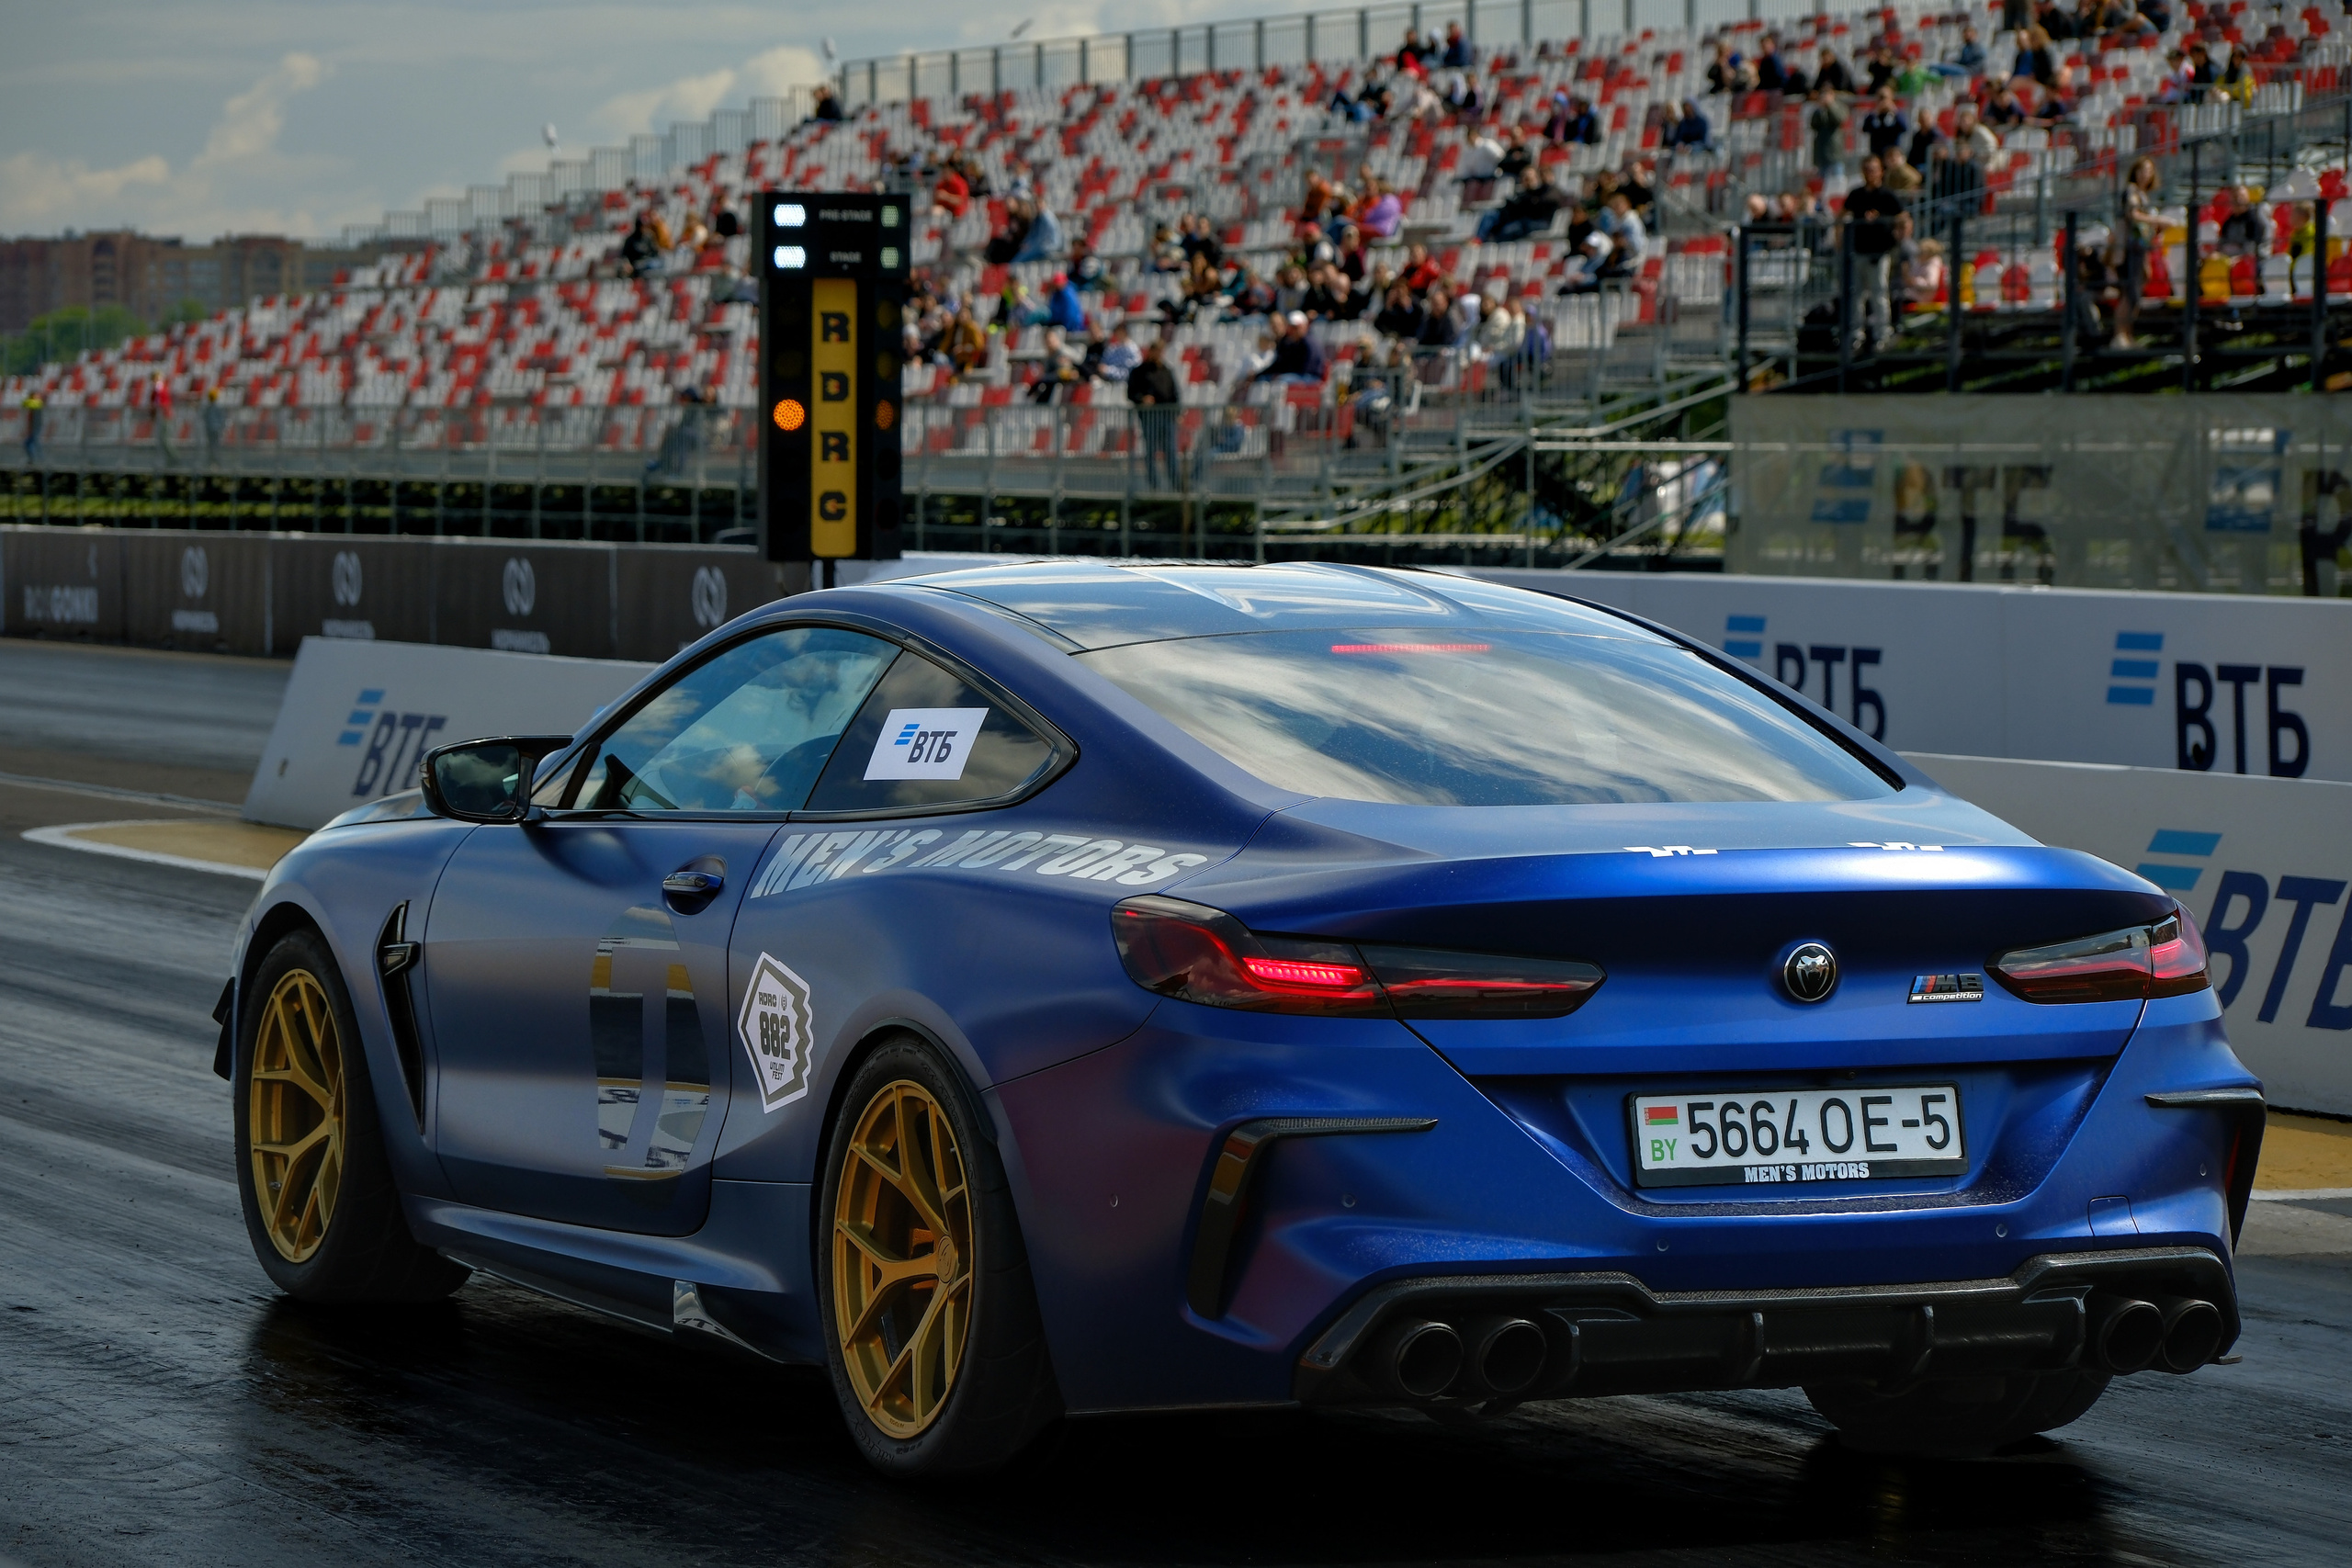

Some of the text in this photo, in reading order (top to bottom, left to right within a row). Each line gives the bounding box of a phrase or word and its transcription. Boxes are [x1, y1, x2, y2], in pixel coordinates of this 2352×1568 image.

[829, 251, 862, 263] STAGE
[820, 311, 850, 522] RDRC
[2176, 662, 2310, 778] ВТБ
[908, 731, 958, 762] ВТБ
[750, 829, 1208, 898] MEN'S MOTORS
[759, 992, 777, 1007] RDRC
[1923, 992, 1982, 1000] competition
[759, 1010, 791, 1060] 882
[772, 1070, 783, 1080] FEST
[1687, 1094, 1951, 1159] 5664 OE-5
[1651, 1138, 1677, 1162] BY
[1744, 1162, 1870, 1183] MEN'S MOTORS
